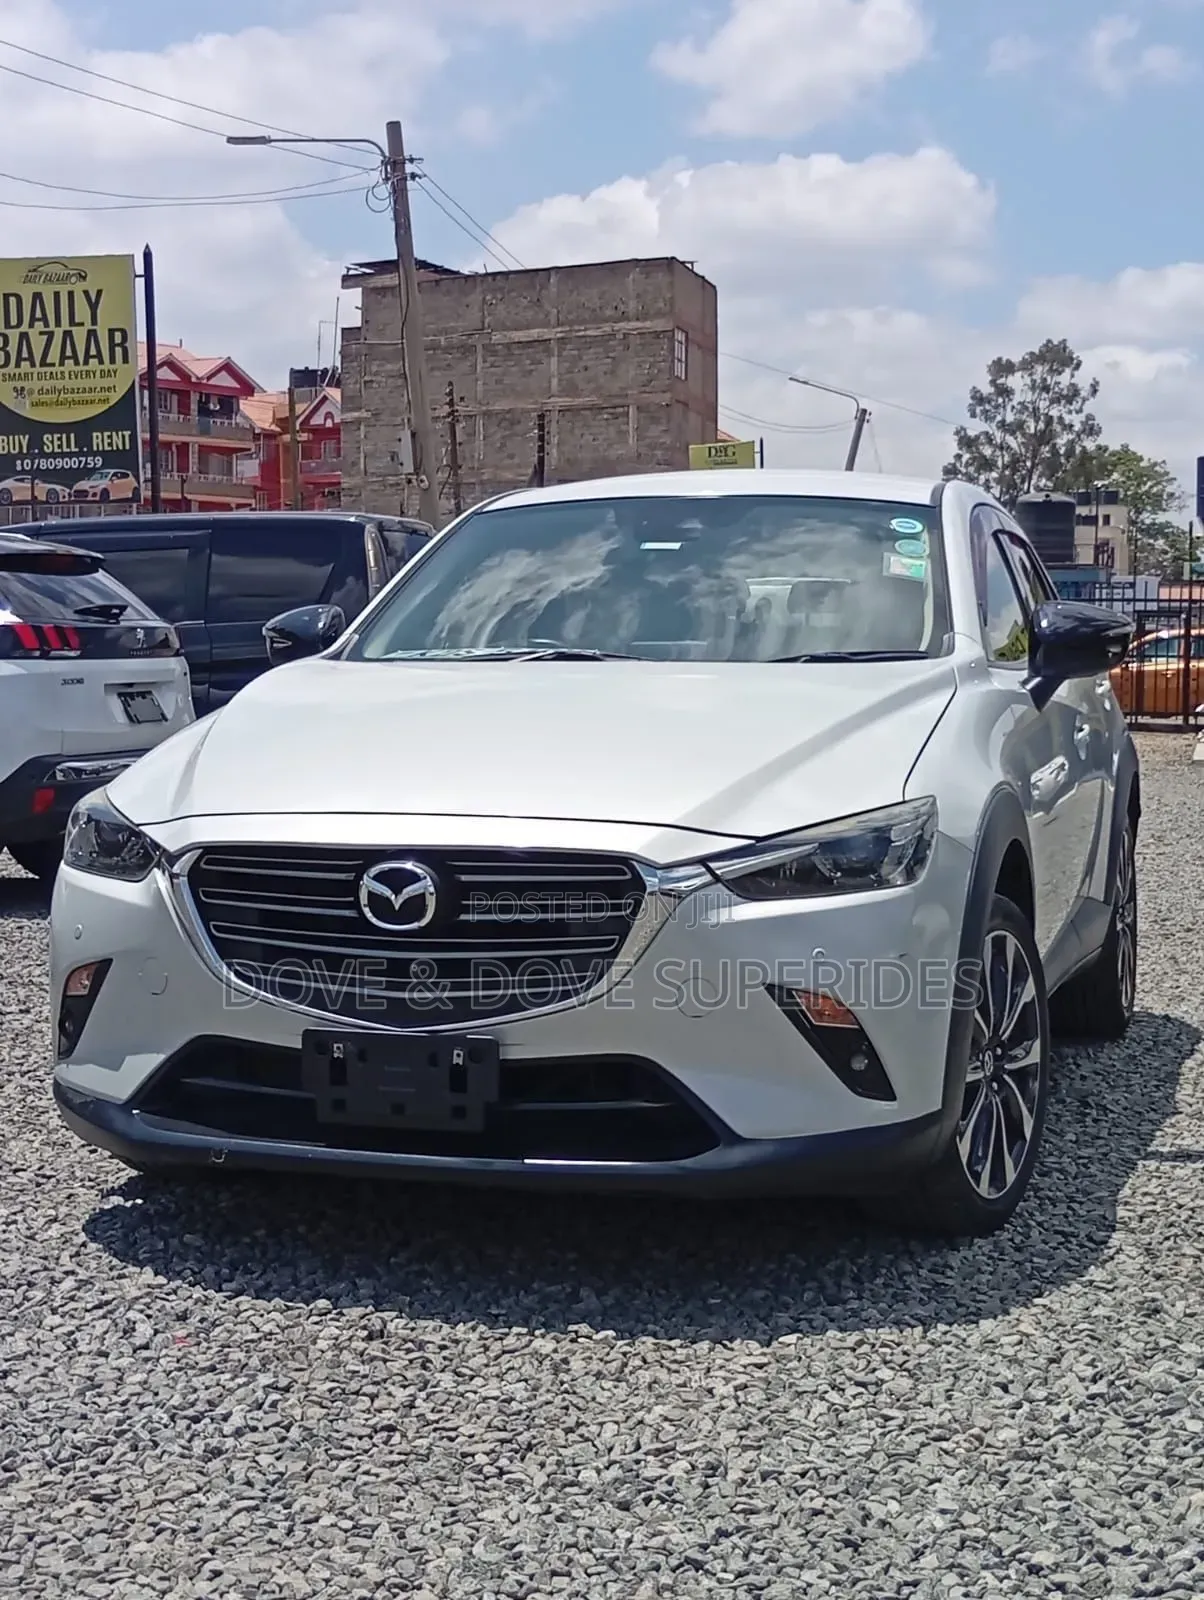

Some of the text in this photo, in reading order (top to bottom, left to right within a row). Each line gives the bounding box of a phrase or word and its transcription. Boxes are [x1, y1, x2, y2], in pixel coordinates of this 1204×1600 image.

[2, 289, 103, 329] DAILY
[0, 328, 129, 369] BAZAAR
[1, 368, 118, 382] SMART DEALS EVERY DAY
[0, 430, 131, 454] BUY SELL RENT
